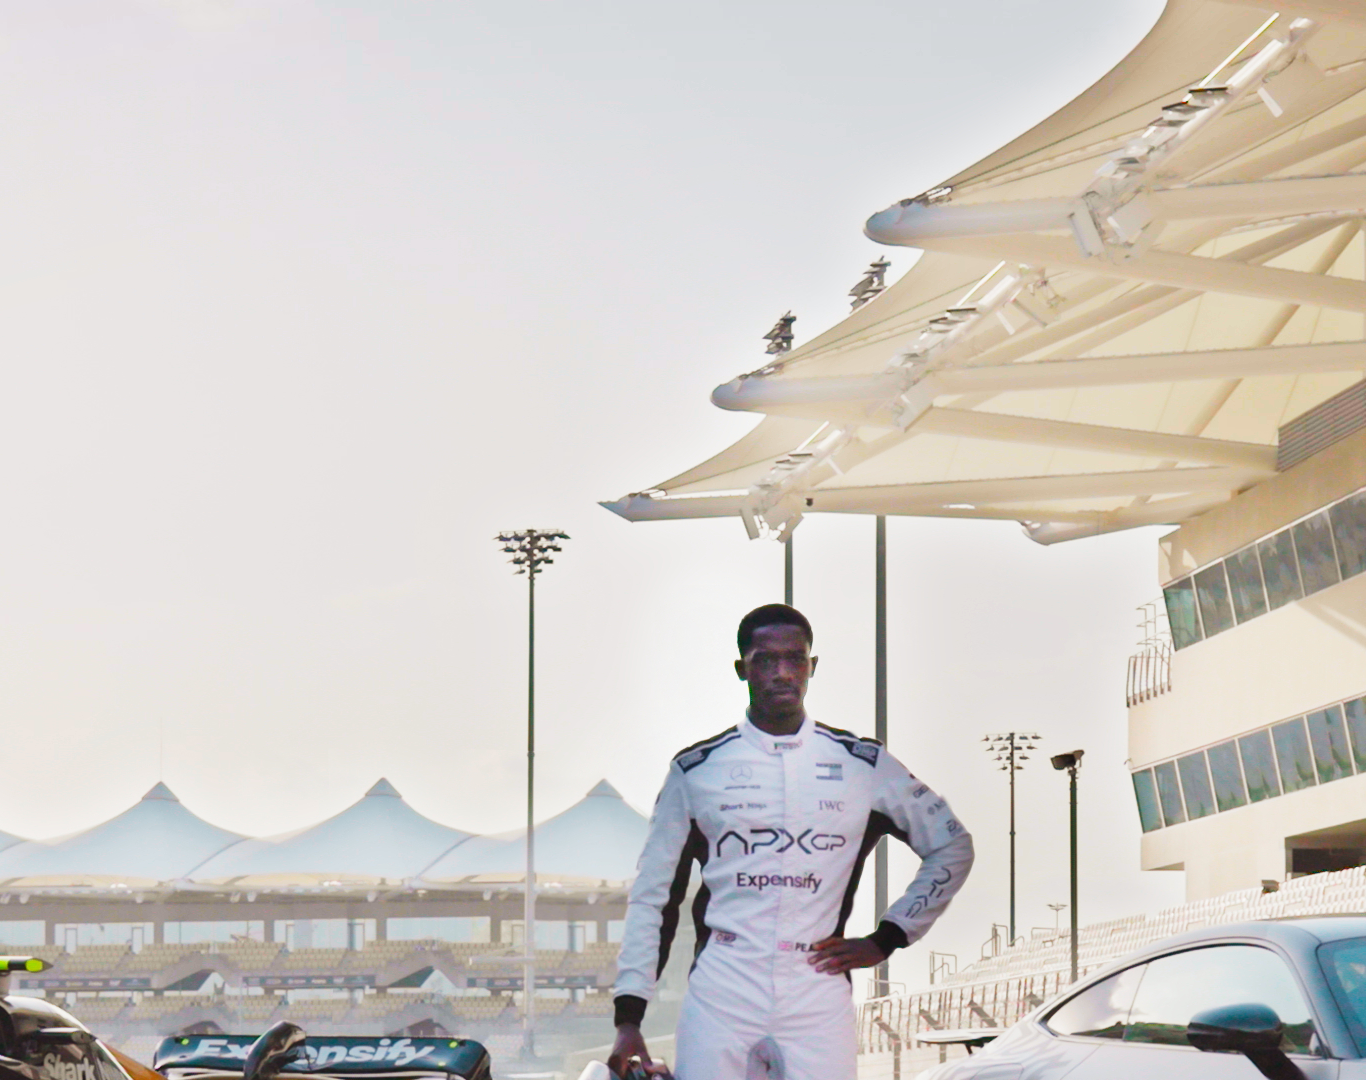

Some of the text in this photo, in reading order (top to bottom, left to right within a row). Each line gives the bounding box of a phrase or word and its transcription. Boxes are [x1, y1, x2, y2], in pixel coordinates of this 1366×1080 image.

[819, 800, 845, 812] IWC
[736, 872, 823, 895] Expensify
[195, 1038, 435, 1066] Exensify
